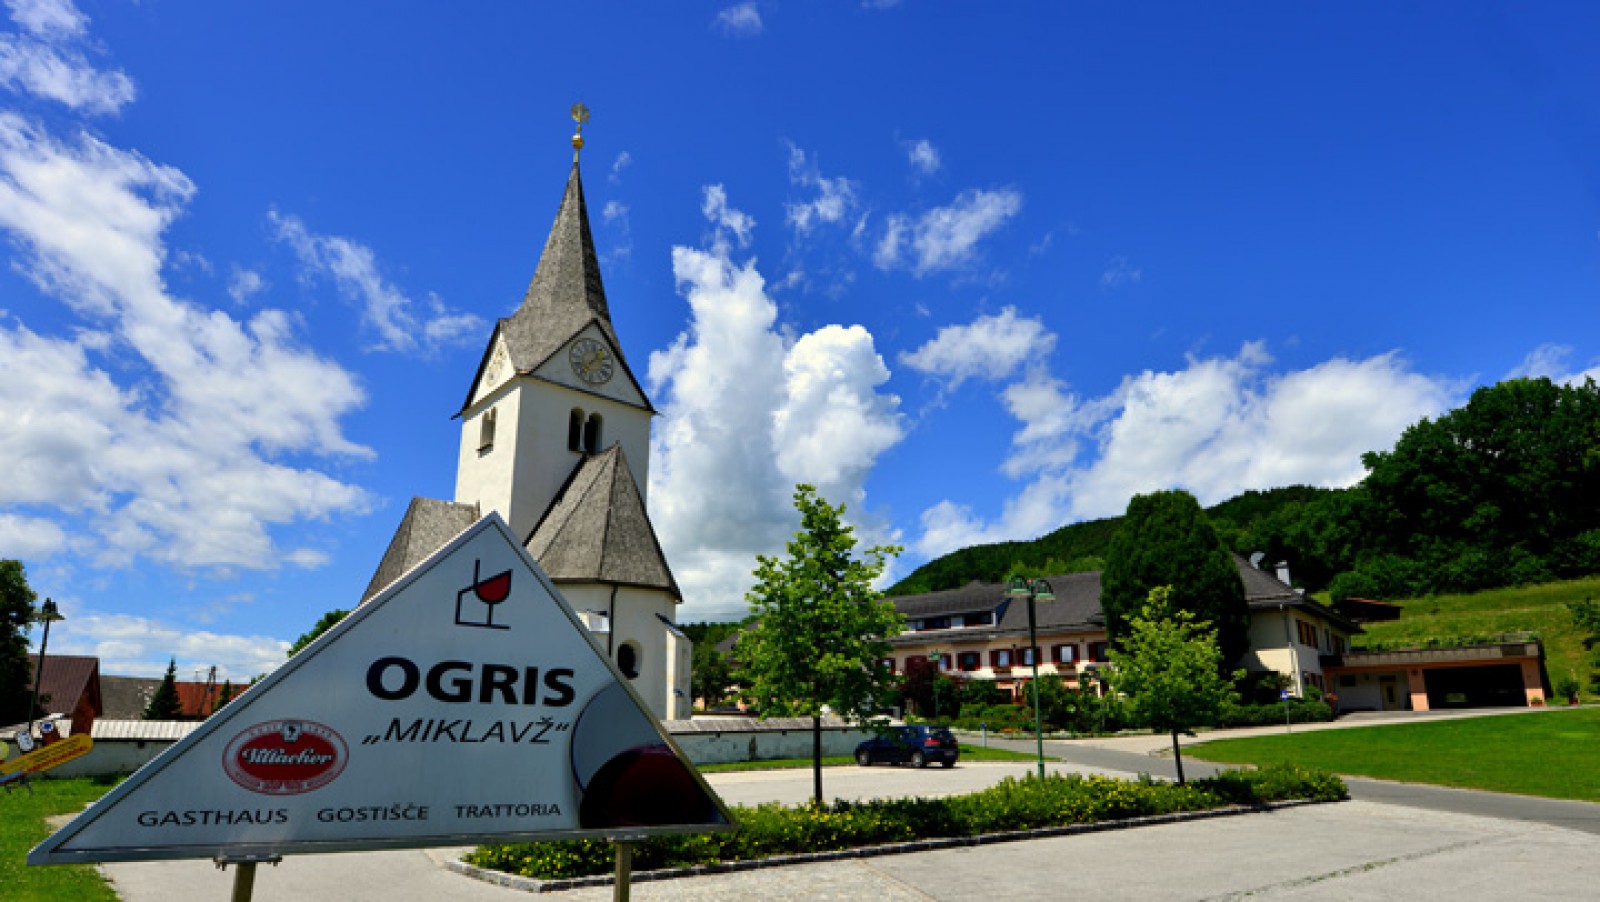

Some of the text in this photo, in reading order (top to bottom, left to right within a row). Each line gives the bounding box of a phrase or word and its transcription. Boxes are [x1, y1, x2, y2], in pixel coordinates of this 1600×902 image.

[366, 656, 576, 707] OGRIS
[138, 802, 561, 827] GASTHAUS GOSTIŠČE TRATTORIA
